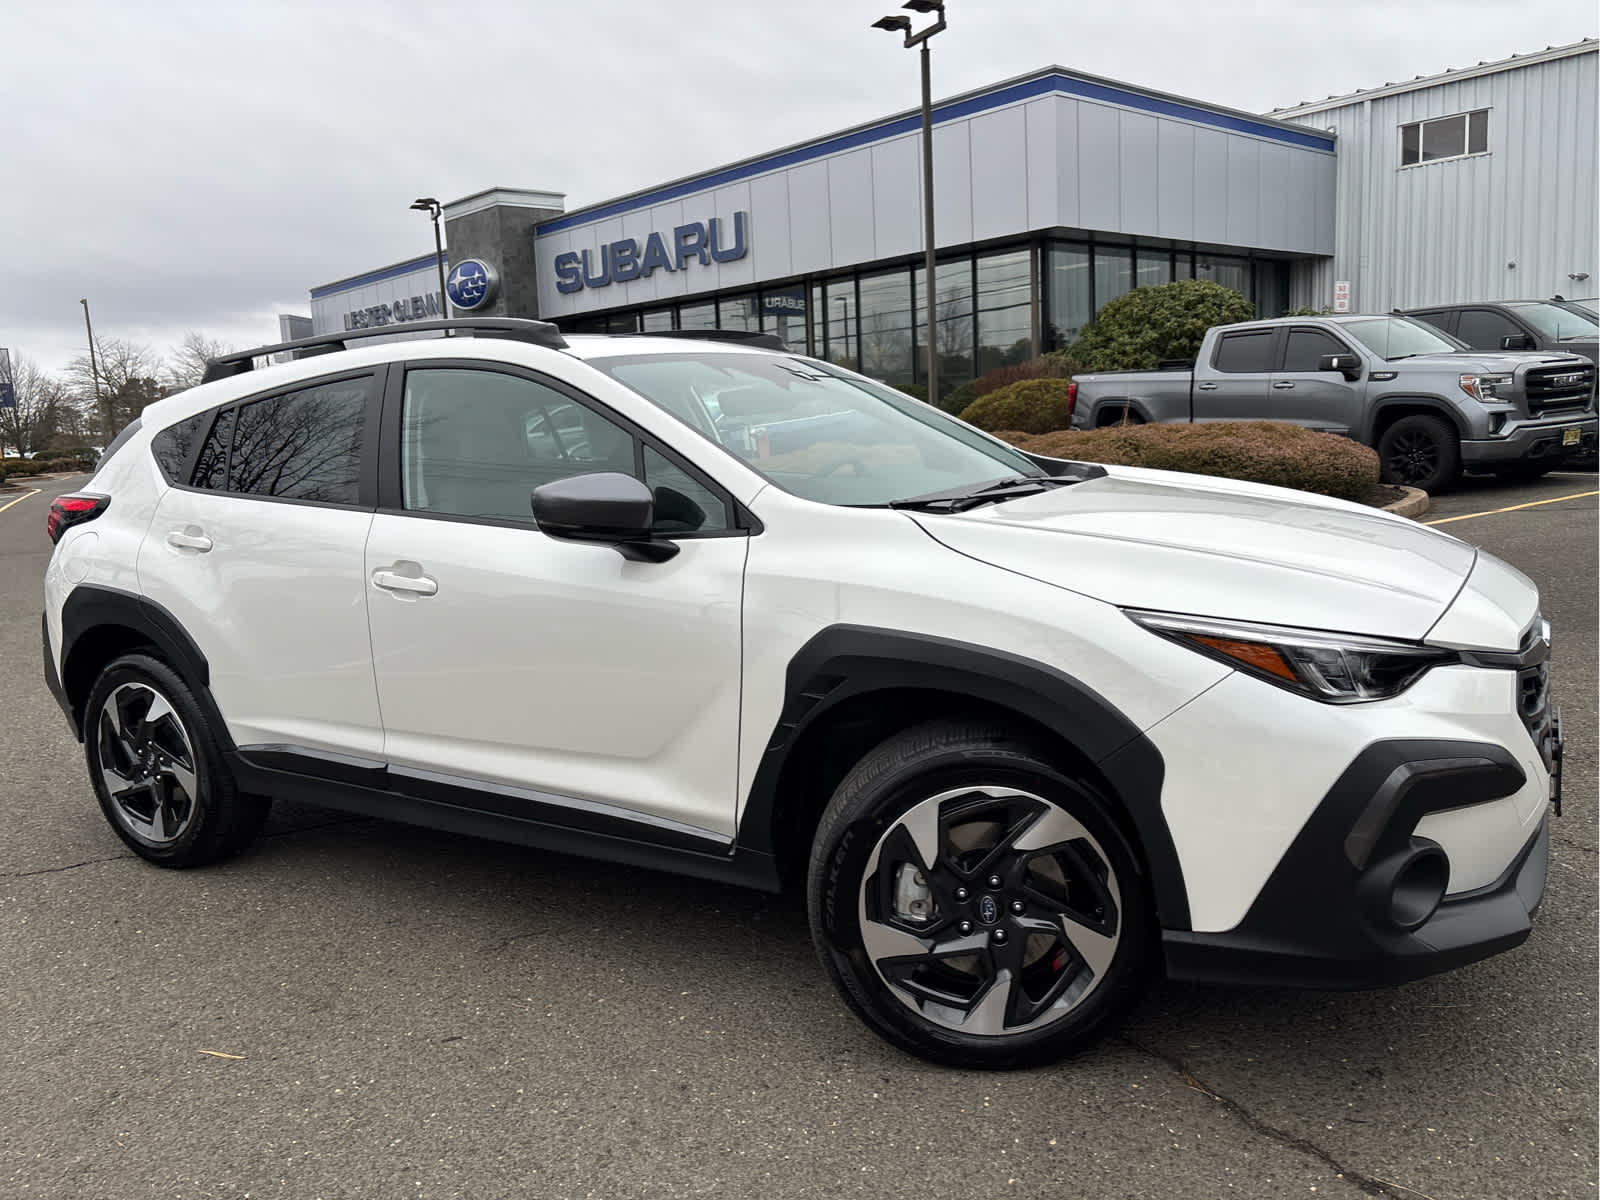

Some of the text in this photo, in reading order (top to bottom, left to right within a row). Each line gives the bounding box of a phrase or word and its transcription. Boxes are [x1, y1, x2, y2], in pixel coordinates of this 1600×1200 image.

[554, 211, 747, 294] SUBARU
[343, 291, 444, 331] LESTER GLENN
